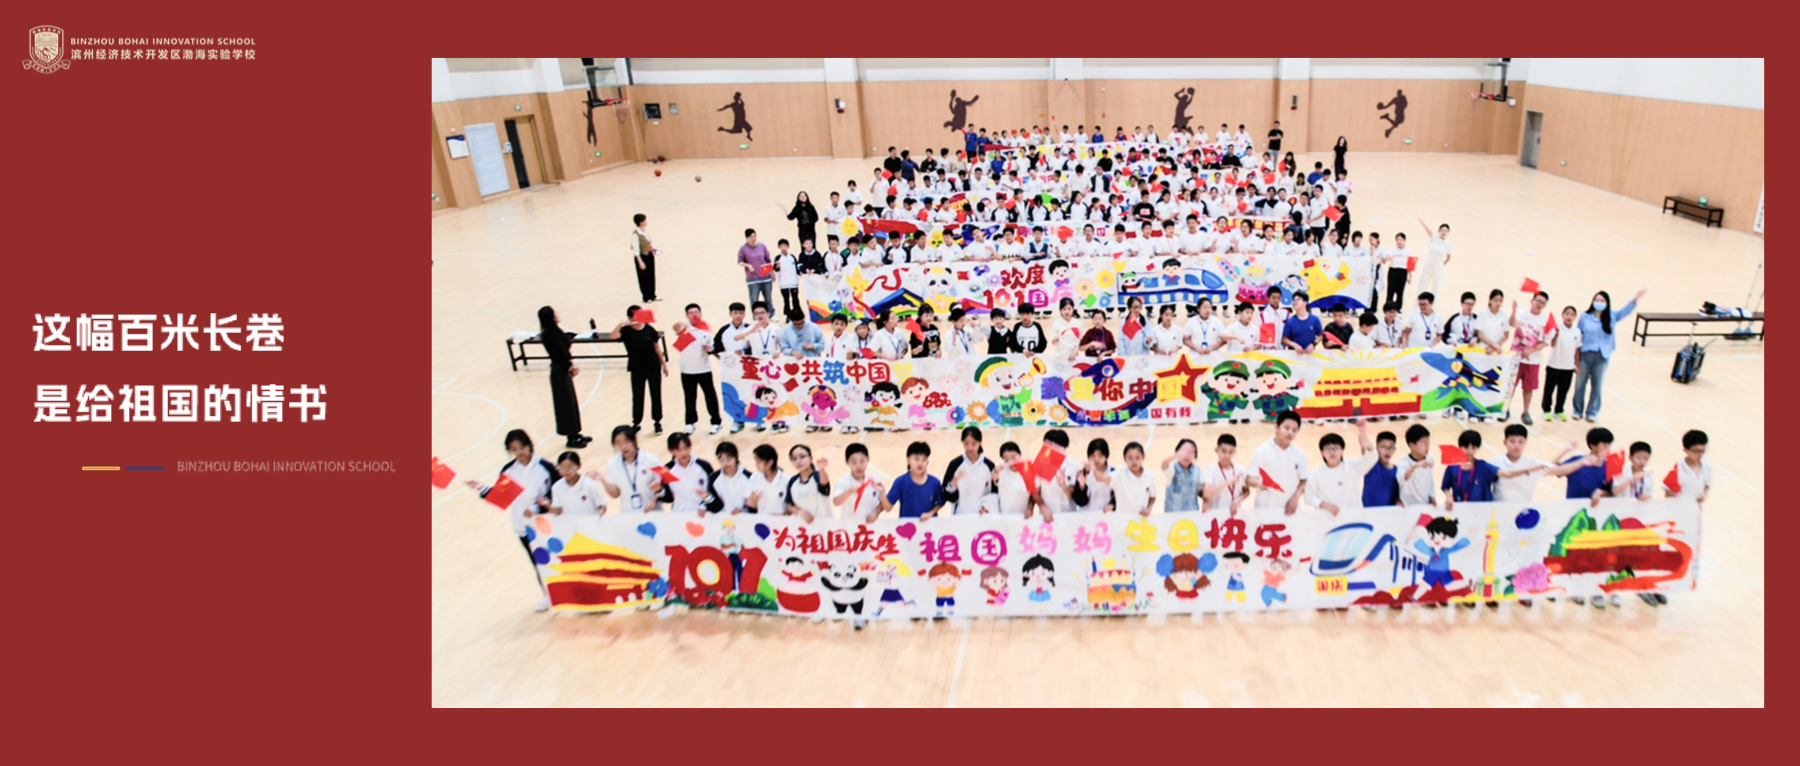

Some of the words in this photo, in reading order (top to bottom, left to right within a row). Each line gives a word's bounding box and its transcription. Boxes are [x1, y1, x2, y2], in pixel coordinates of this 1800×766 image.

[1000, 263, 1046, 290] 欢度
[773, 524, 900, 555] 为祖国庆生
[919, 516, 1293, 566] 祖国妈妈生日快乐
